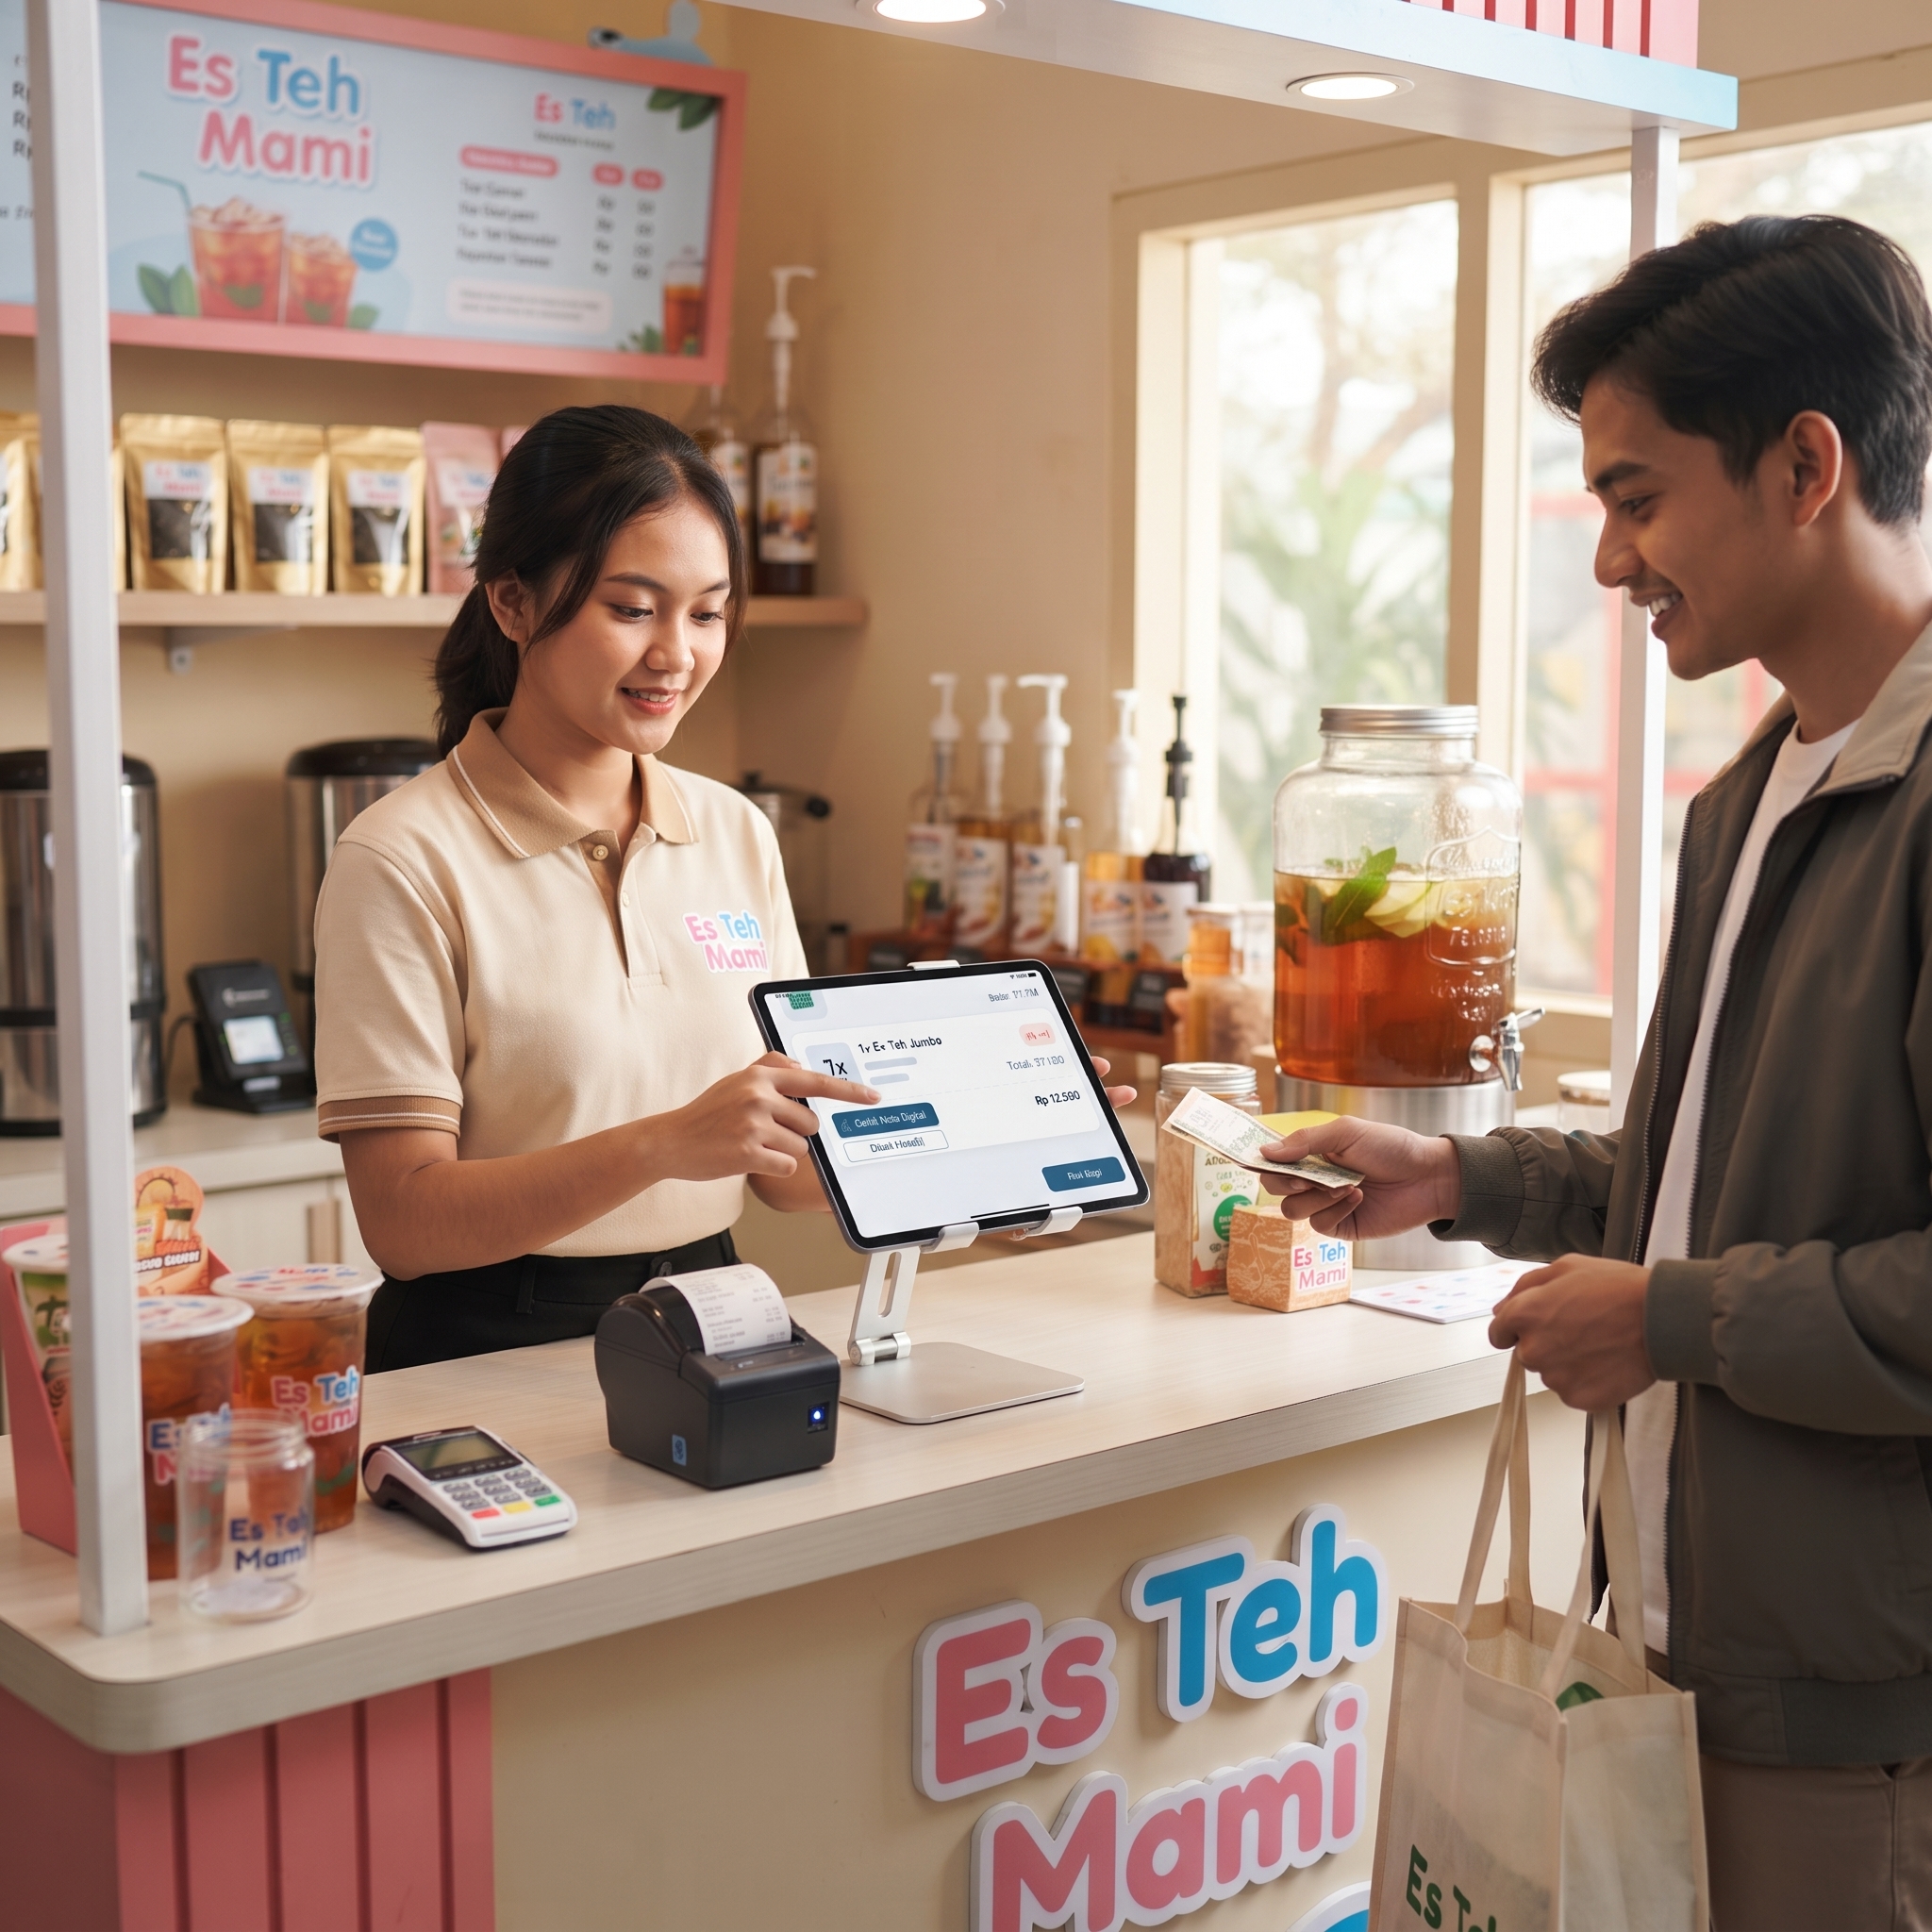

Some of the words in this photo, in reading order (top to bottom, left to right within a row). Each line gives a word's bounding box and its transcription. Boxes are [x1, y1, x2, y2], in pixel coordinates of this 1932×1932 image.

[170, 36, 234, 98] Es
[257, 48, 360, 114] Teh
[199, 109, 372, 182] Mami
[684, 915, 718, 941] Es
[719, 912, 760, 939] Teh
[705, 941, 768, 970] Mami
[887, 1040, 908, 1050] Teh
[909, 1037, 942, 1048] Jumbo
[1035, 1095, 1049, 1107] Rp
[1294, 1247, 1312, 1267] Es
[1319, 1241, 1345, 1262] Teh
[1299, 1262, 1345, 1290] Mami
[272, 1377, 308, 1407] Es
[230, 1518, 264, 1541] Es
[936, 1618, 1108, 1784] Es
[1143, 1520, 1378, 1707] Teh
[992, 1697, 1357, 1932] Mami
[1406, 1843, 1442, 1930] Es
